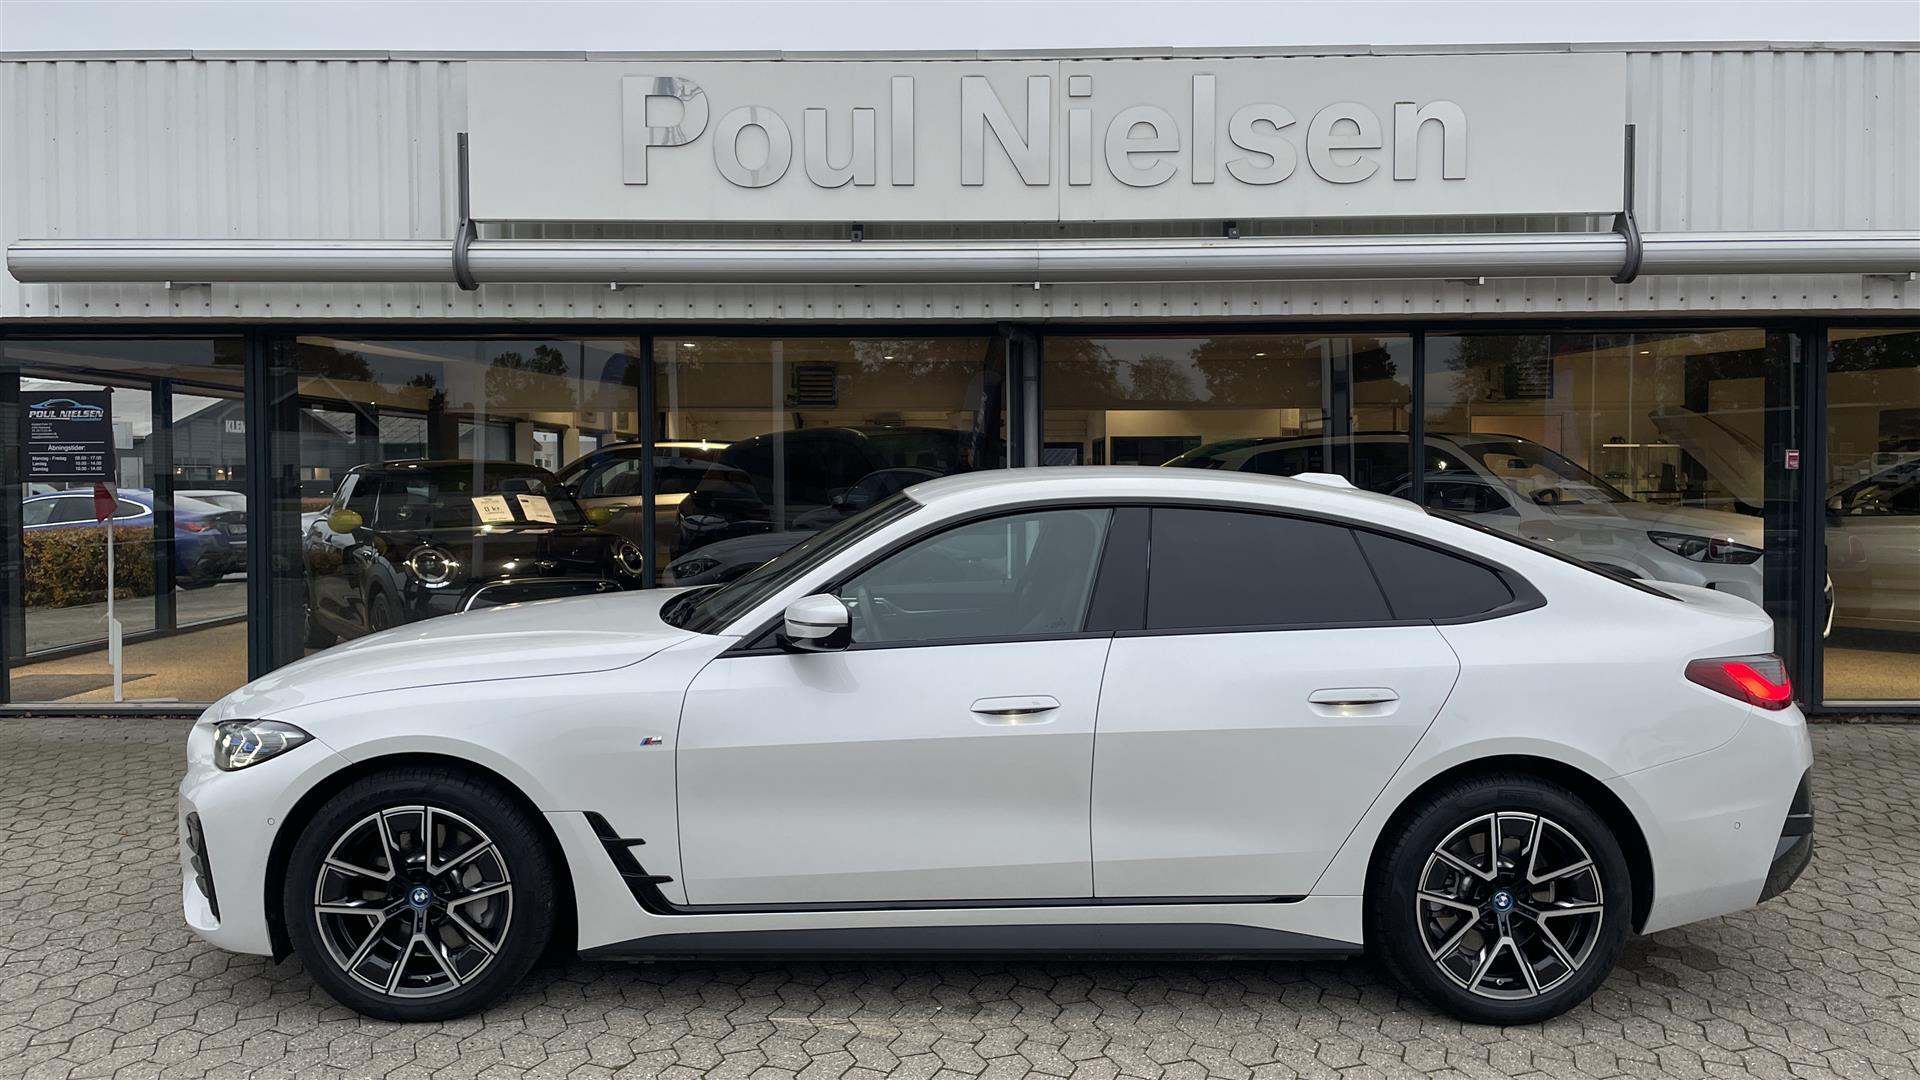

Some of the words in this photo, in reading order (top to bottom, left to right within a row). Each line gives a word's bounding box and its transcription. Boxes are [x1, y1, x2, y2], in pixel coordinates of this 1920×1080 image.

[621, 74, 916, 189] Poul
[959, 73, 1469, 188] Nielsen
[28, 410, 57, 418] POUL
[59, 410, 104, 418] NIELSEN
